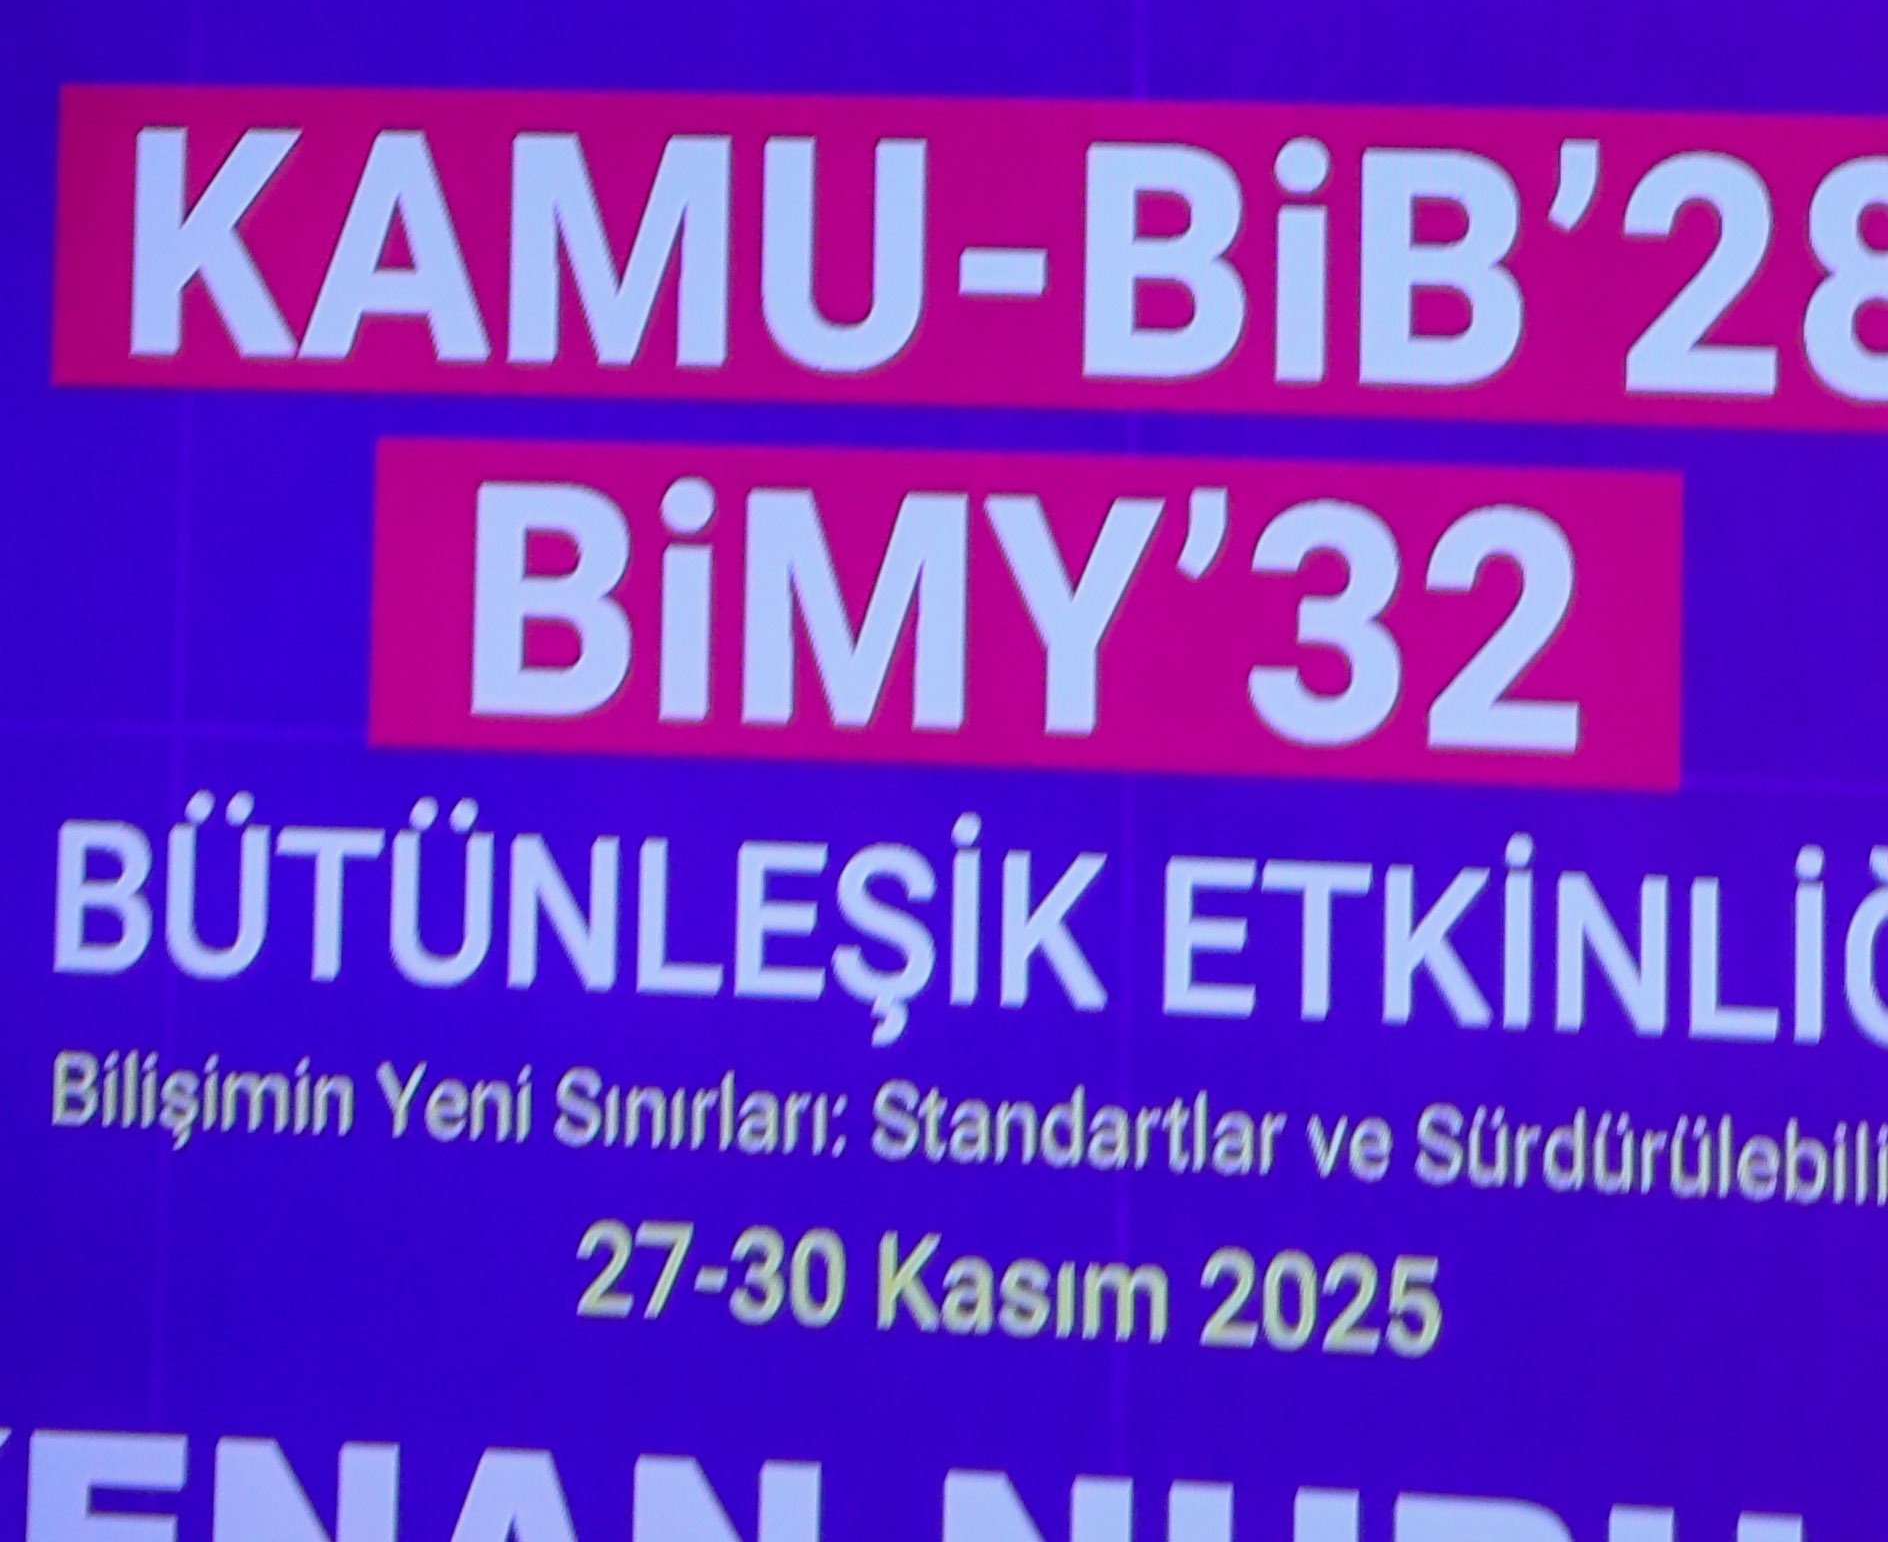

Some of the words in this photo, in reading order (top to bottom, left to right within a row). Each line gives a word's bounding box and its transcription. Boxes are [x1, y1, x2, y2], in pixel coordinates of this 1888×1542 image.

[471, 477, 1579, 755] BiMY’32
[51, 789, 1108, 1046] BÜTÜNLEŞİK
[51, 1050, 354, 1150] Bilişimin
[376, 1061, 532, 1144] Yeni
[870, 1080, 1285, 1176] Standartlar
[1307, 1116, 1391, 1181] ve
[575, 1221, 846, 1322] 27-30
[874, 1230, 1169, 1342] Kasım
[1200, 1247, 1441, 1357] 2025
